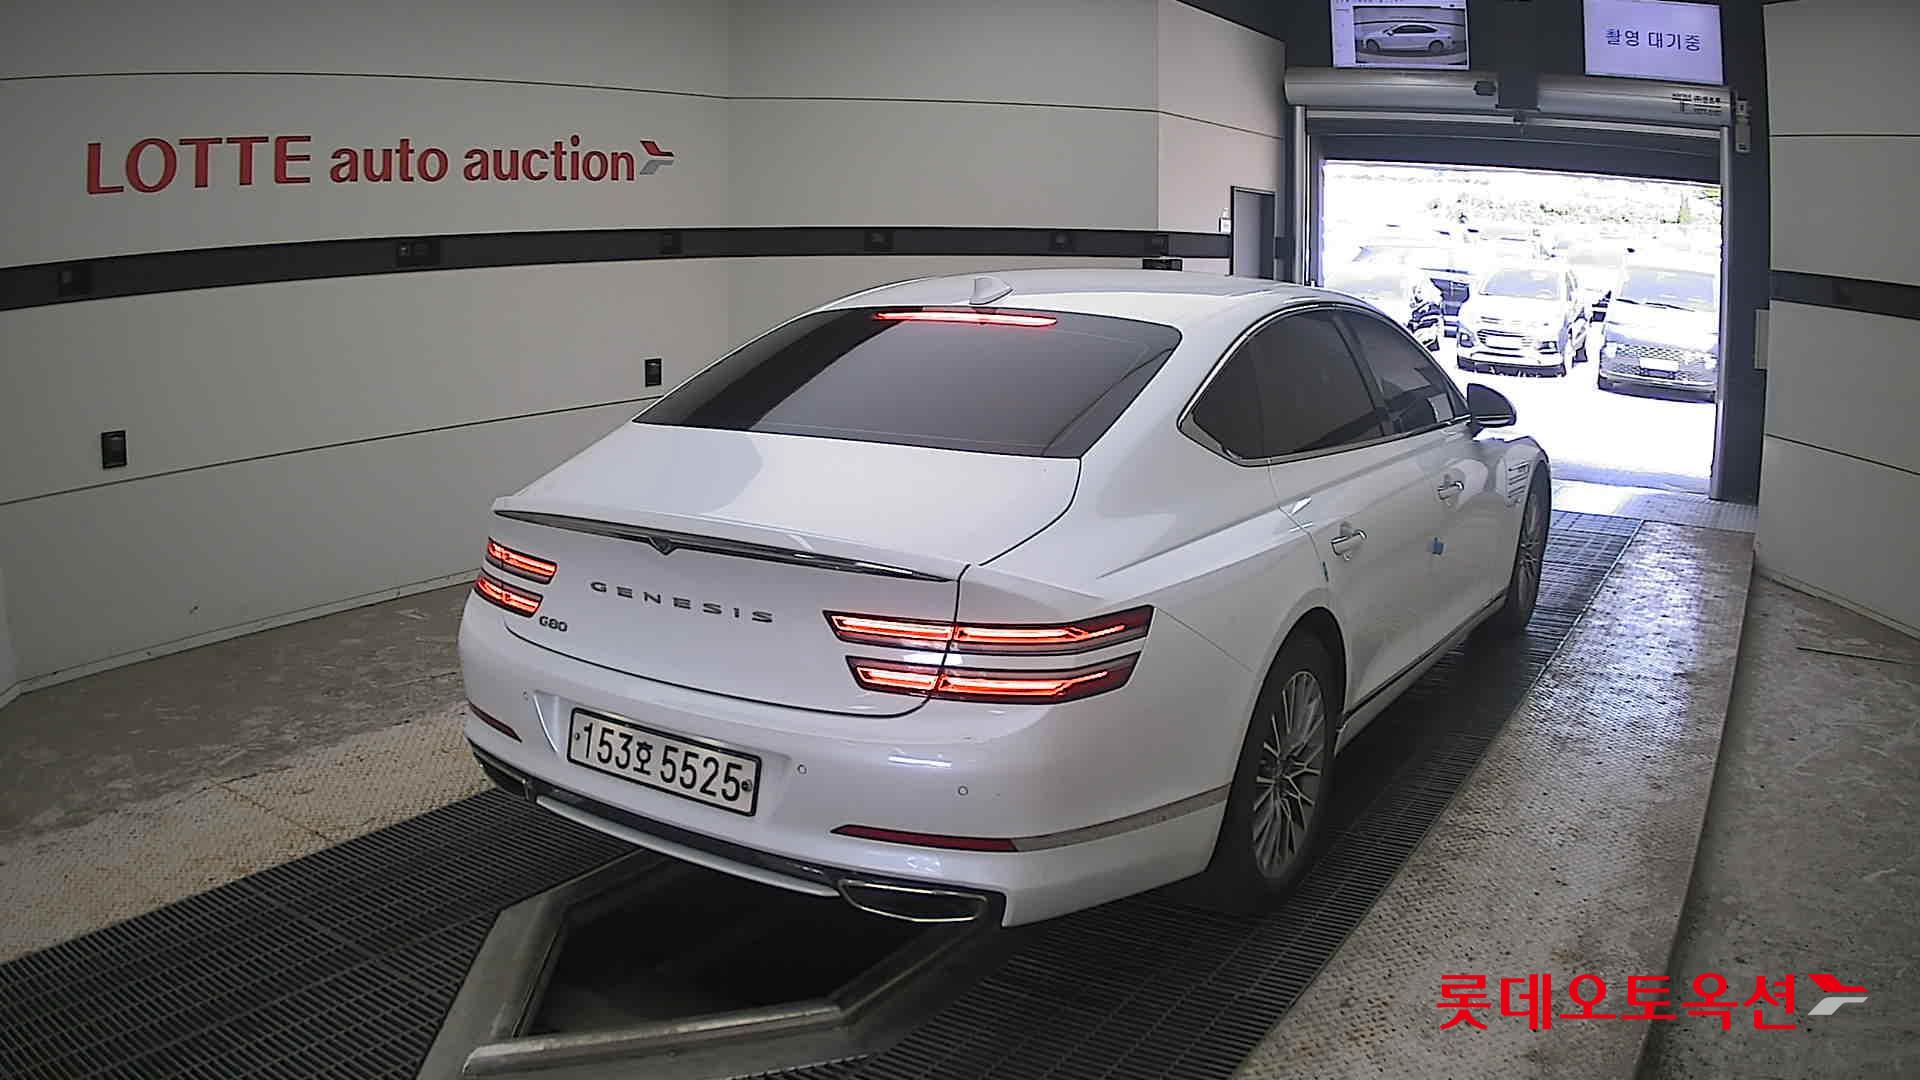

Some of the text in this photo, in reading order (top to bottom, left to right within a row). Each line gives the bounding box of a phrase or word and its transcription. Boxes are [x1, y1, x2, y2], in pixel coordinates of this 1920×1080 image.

[1647, 31, 1702, 53] 대기중
[87, 133, 637, 195] LOTTE auto auction
[538, 614, 569, 633] G80
[589, 580, 774, 624] GENESIS
[659, 744, 744, 803] 5525
